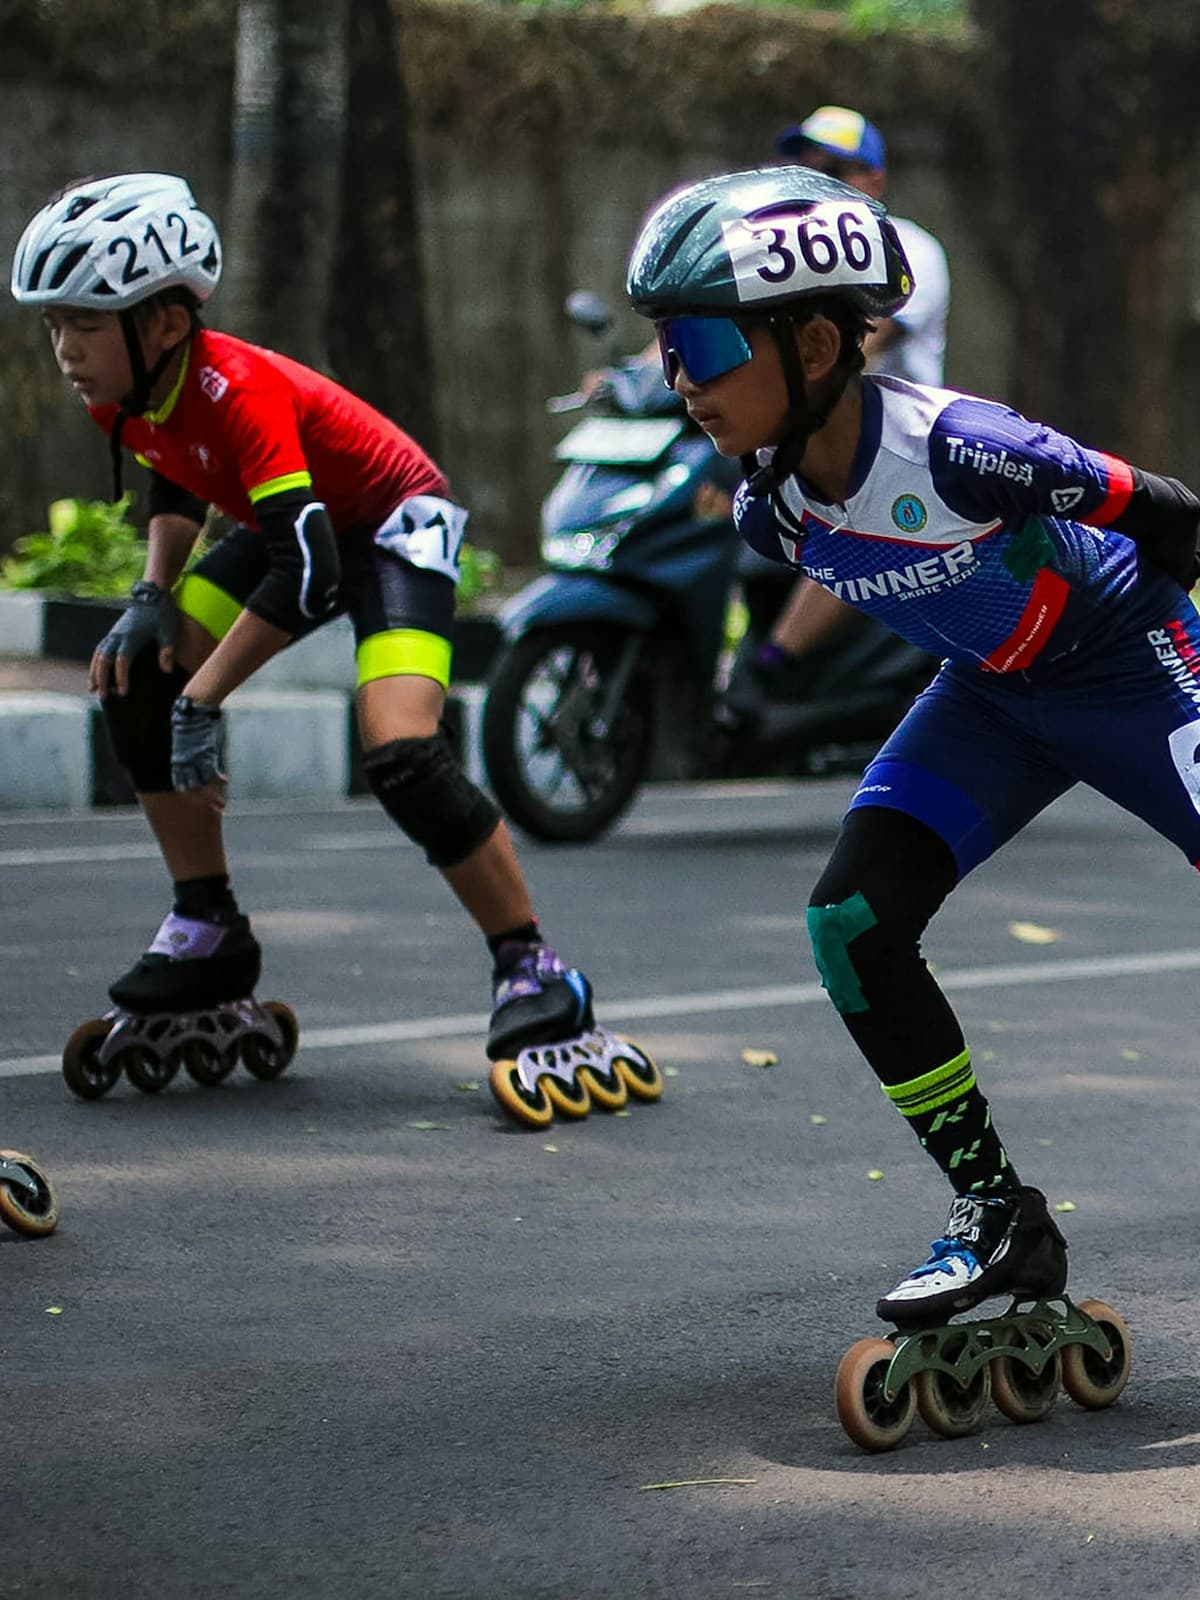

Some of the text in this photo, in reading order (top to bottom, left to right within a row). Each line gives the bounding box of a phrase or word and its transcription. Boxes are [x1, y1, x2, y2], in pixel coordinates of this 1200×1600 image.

[108, 212, 199, 285] 212
[752, 212, 872, 283] 366
[803, 565, 836, 581] THE
[896, 584, 942, 601] SKATE
